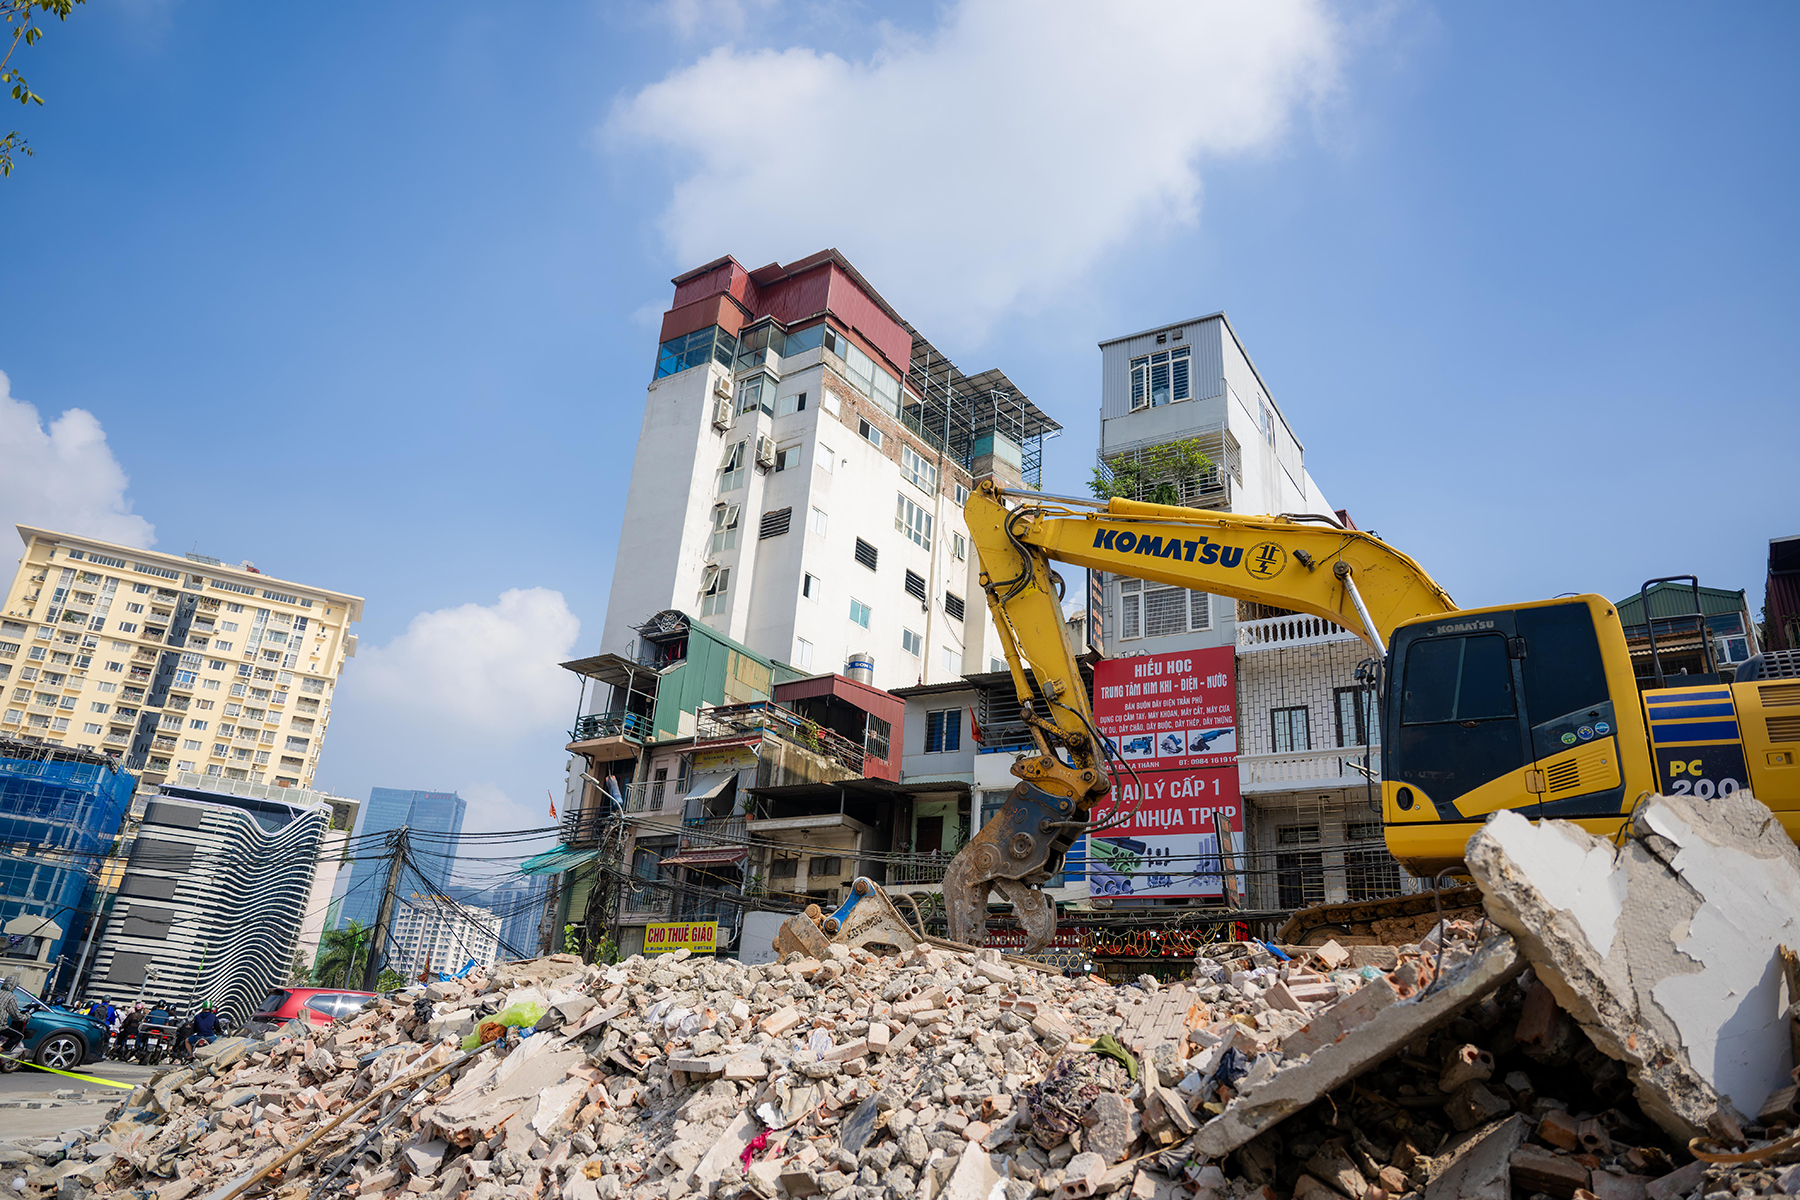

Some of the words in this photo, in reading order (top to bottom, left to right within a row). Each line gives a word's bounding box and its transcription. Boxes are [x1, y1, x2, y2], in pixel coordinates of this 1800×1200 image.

[1093, 528, 1244, 568] KOMATSU
[1437, 620, 1494, 634] KOMATSU
[1135, 658, 1162, 677] HIẾU
[1167, 659, 1192, 676] HỌC
[1101, 685, 1124, 699] TRUNG
[1126, 682, 1140, 696] TÂM
[1143, 682, 1158, 694] KIM
[1181, 676, 1198, 692] ĐIỆN
[1207, 672, 1227, 688] NƯỚC
[1670, 760, 1702, 776] PC
[1145, 779, 1165, 800] LÝ
[1170, 775, 1205, 798] CẤP
[1212, 779, 1219, 795] 1
[1672, 778, 1739, 800] 200
[1097, 808, 1130, 828] ỐNG
[1136, 808, 1184, 829] NHỰA
[648, 928, 665, 942] CHO
[668, 924, 689, 942] THUÊ
[692, 923, 713, 942] GIÁO
